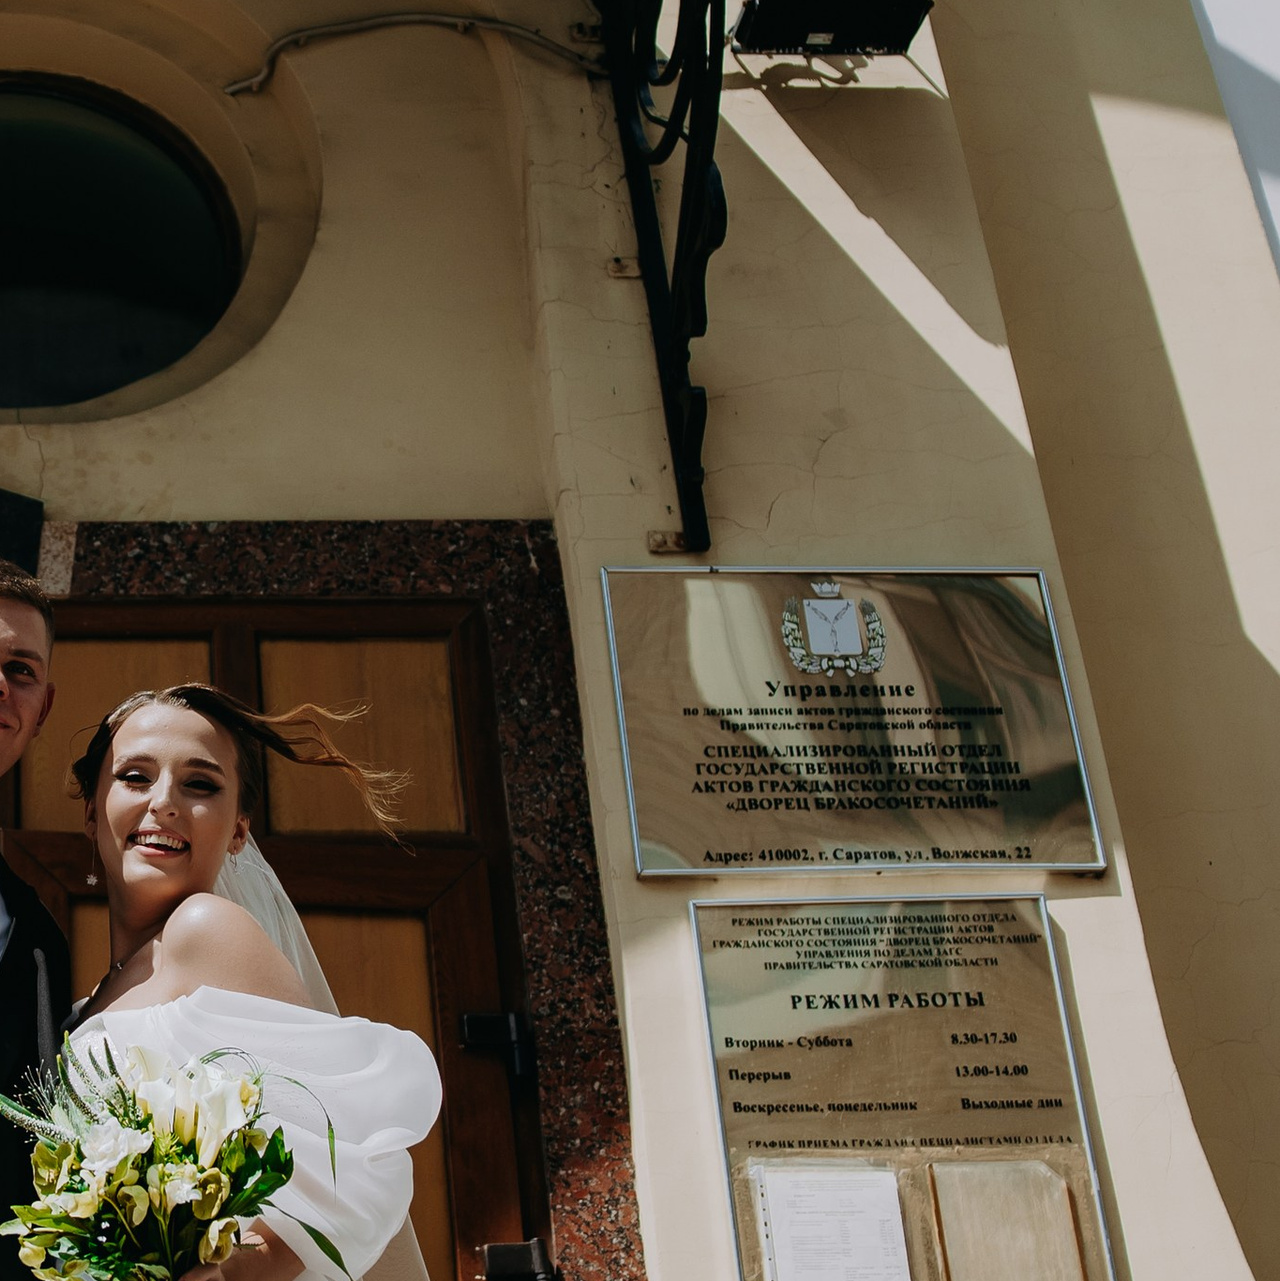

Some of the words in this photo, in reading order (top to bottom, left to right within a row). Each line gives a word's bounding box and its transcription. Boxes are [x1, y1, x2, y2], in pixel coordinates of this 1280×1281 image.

[765, 681, 915, 701] Управление
[683, 707, 699, 716] по
[703, 707, 743, 716] делам
[747, 707, 792, 716] записи
[797, 707, 835, 716] актов
[839, 706, 932, 718] гражданского
[935, 706, 1004, 716] состояния
[720, 720, 824, 733] Правительства
[828, 719, 915, 733] Саратовской
[919, 719, 973, 730] области
[703, 742, 937, 759] СПЕЦИАЛИЗИРОВАННЫЙ
[941, 744, 1003, 758] ОТДЕЛ
[695, 759, 882, 777] ГОСУДАРСТВЕННОЙ
[887, 761, 1021, 776] РЕГИСТРАЦИИ
[691, 780, 754, 793] АКТОВ
[759, 779, 911, 794] ГРАЖДАНСКОГО
[915, 778, 1031, 792] СОСТОЯНИЯ
[726, 797, 810, 812] «ДВОРЕЦ
[815, 793, 999, 810] БРАКОСОЧЕТАНИЙ»
[703, 850, 754, 864] Адрес:
[758, 848, 815, 862] 410002,
[818, 851, 828, 861] г.
[832, 848, 901, 863] Саратов,
[904, 850, 929, 863] ул.
[931, 847, 1012, 861] Волжская,
[1014, 846, 1032, 859] 22
[731, 917, 774, 926] РЕЖИМ
[776, 916, 821, 926] РАБОТЫ
[824, 914, 970, 926] СПЕЦИАЛИЗИРОВАННОГО
[972, 913, 1017, 923] ОТДЕЛА
[757, 925, 870, 937] ГОСУДАРСТВЕННОЙ
[873, 925, 954, 936] РЕГИСТРАЦИИ
[957, 924, 995, 933] АКТОВ
[712, 939, 804, 949] ГРАЖДАНСКОГО
[806, 938, 877, 948] СОСТОЯНИЯ
[795, 949, 871, 959] УПРАВЛЕНИЯ
[874, 949, 890, 957] ПО
[893, 948, 933, 958] ДЕЛАМ
[935, 947, 963, 956] ЗАГС
[764, 961, 857, 970] ПРАВИТЕЛЬСТВА
[861, 957, 942, 969] САРАТОВСКОЙ
[944, 957, 999, 967] ОБЛАСТИ
[791, 993, 880, 1010] РЕЖИМ
[887, 991, 985, 1009] РАБОТЫ
[724, 1037, 784, 1051] Вторник
[796, 1035, 853, 1050] Суббота
[950, 1032, 1018, 1045] 8.30-17.30
[728, 1069, 792, 1083] Перерыв
[955, 1064, 1029, 1077] 13.00-14.00
[732, 1101, 824, 1115] Воскресенье,
[827, 1101, 918, 1112] понедельник
[960, 1097, 1033, 1110] Выходные
[1037, 1098, 1063, 1109] дни
[748, 1139, 795, 1149] ГРАФИК
[798, 1138, 849, 1148] ПРИЕМА
[851, 1138, 908, 1148] ГРАЖДАН
[911, 1135, 1021, 1147] СПЕЦИАЛИСТАМИ
